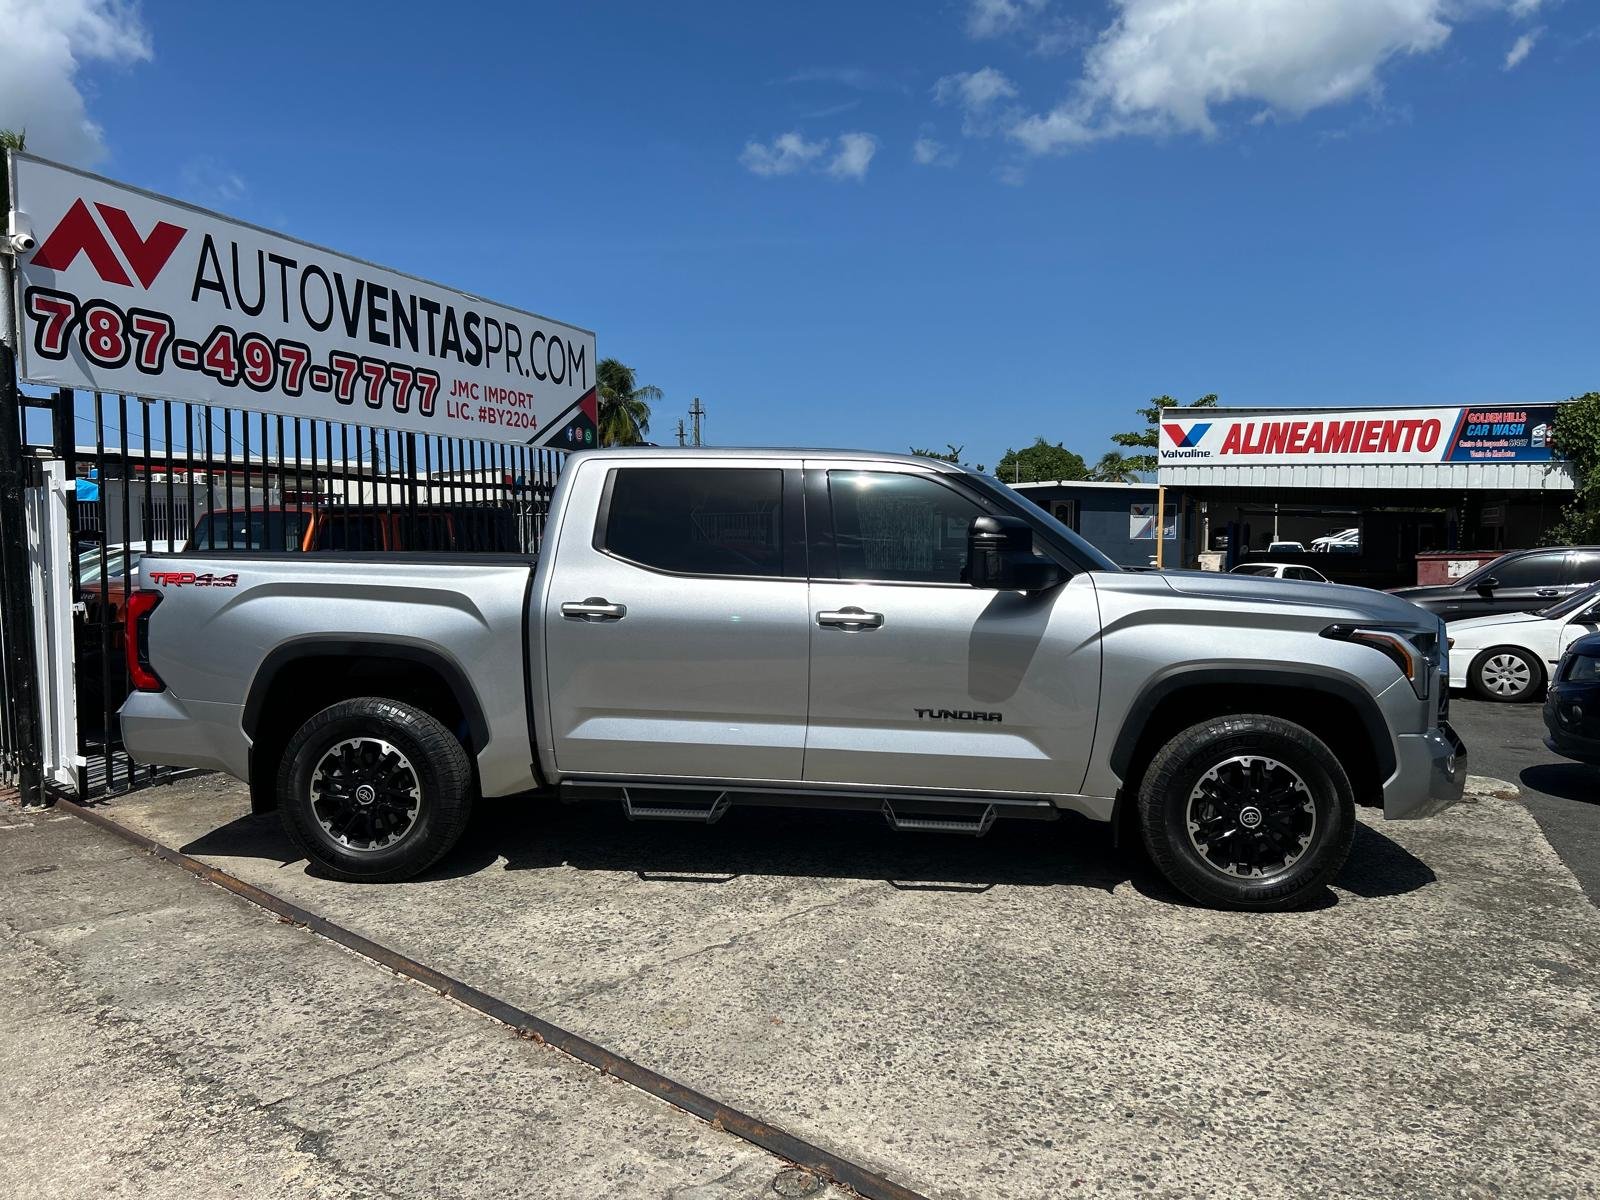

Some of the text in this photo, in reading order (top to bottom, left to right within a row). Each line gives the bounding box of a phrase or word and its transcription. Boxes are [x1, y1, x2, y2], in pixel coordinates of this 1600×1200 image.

[191, 233, 586, 390] AUTOVENTASPR.COM
[25, 286, 440, 417] 787-497-7777
[450, 379, 534, 410] JMC IMPORT
[447, 400, 538, 430] LIC. #BY2204
[1467, 412, 1527, 423] GOLDEN HILLS
[1219, 418, 1442, 455] ALINEAMIENTO
[1466, 424, 1525, 436] CAR WASH
[1160, 449, 1211, 458] Valvoline
[149, 572, 196, 587] TRD
[913, 707, 1003, 722] TUNDRA
